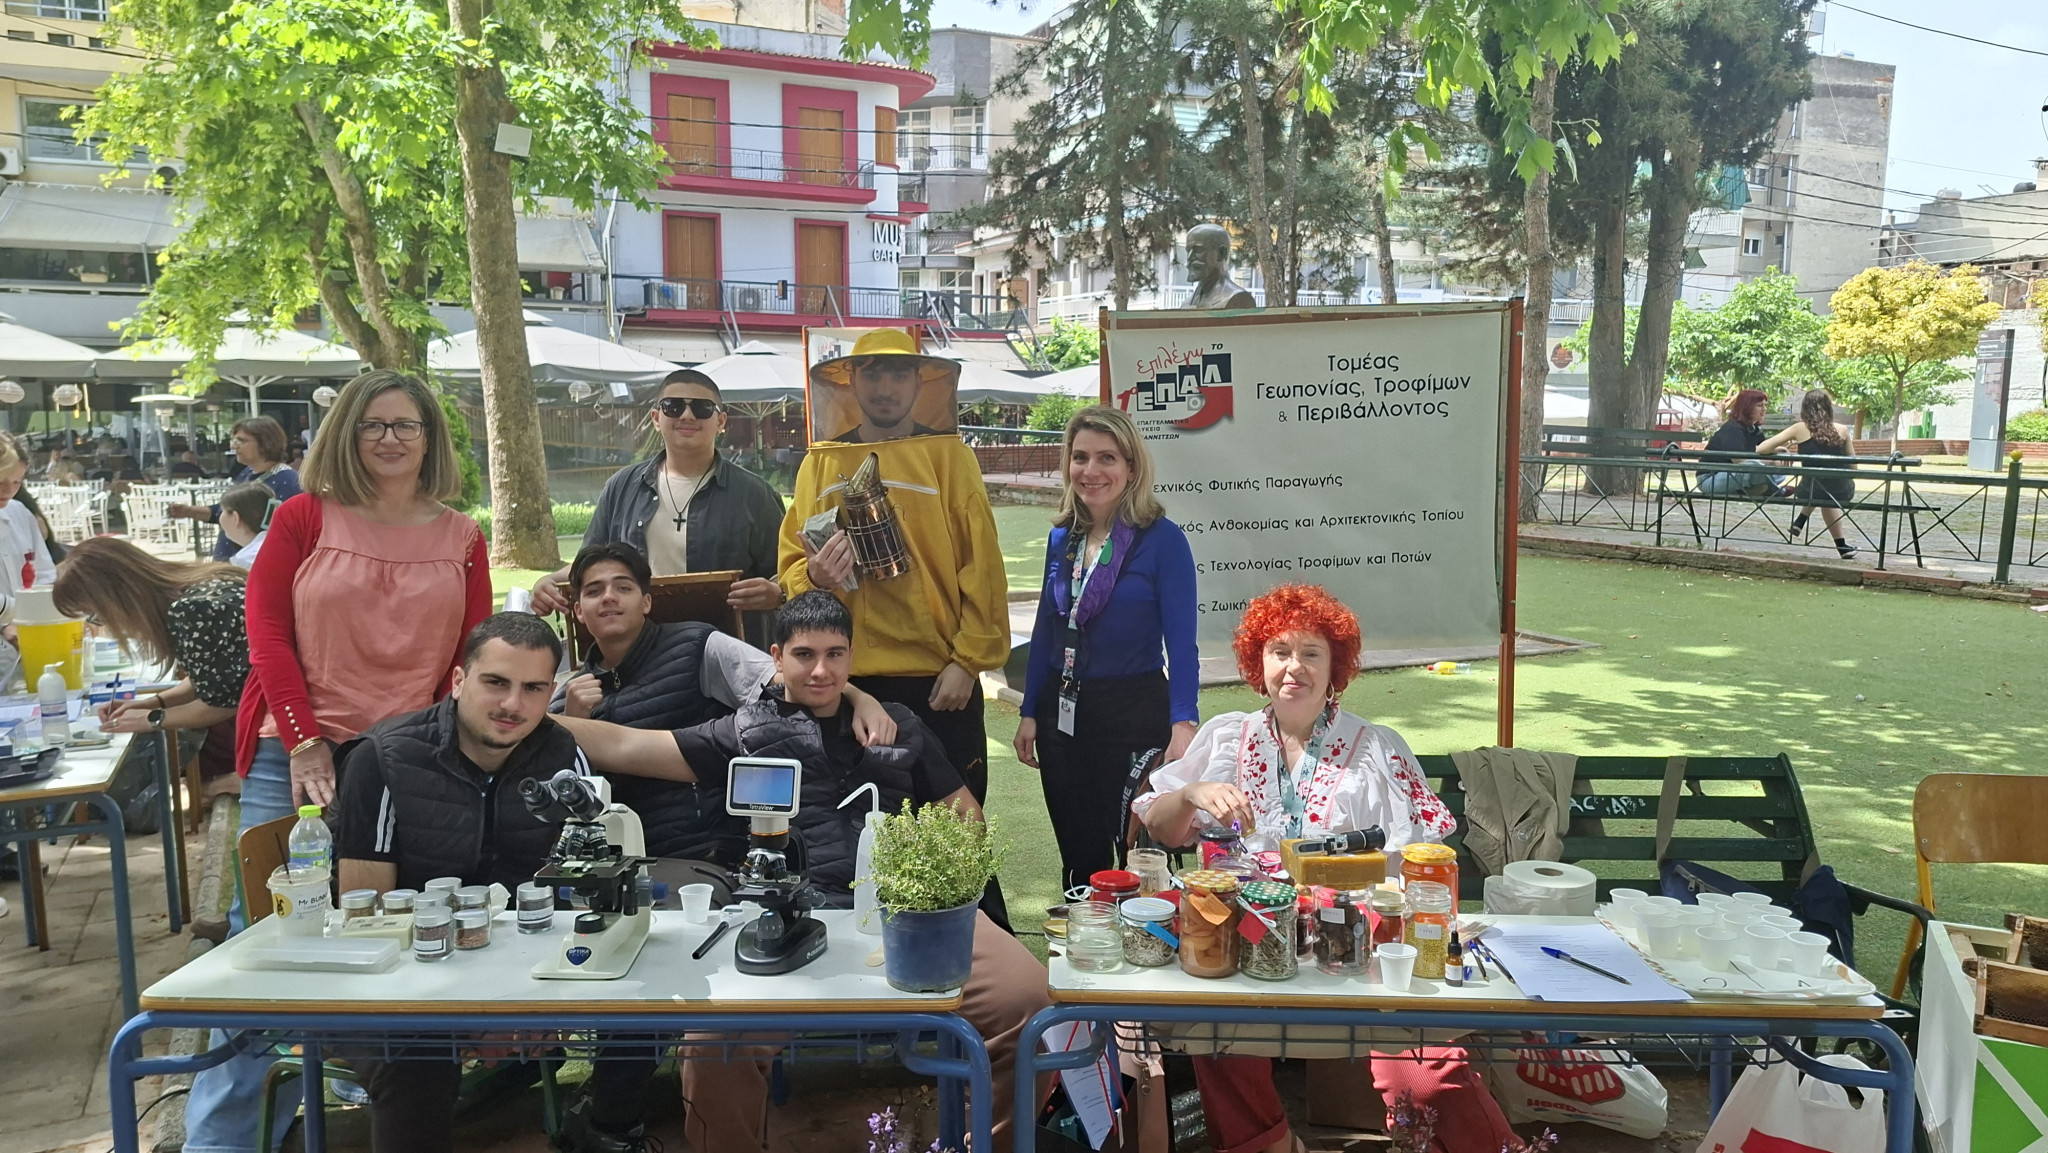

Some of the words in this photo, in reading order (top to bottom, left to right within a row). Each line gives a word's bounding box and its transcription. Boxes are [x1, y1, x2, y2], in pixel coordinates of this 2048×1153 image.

[1327, 352, 1400, 375] Τομέας
[1256, 378, 1365, 400] Γεωπονίας,
[1374, 374, 1471, 397] Τροφίμων
[1278, 411, 1288, 422] &
[1297, 400, 1449, 424] Περιβάλλοντος
[1143, 433, 1180, 441] ΑΝΝΙΤΣΩΝ
[1152, 479, 1203, 494] εχνικός
[1208, 478, 1260, 492] Φυτικής
[1265, 473, 1343, 490] Παραγωγής
[1208, 517, 1289, 533] Ανθοκομίας
[1295, 516, 1315, 528] και
[1319, 510, 1416, 529] Αρχιτεκτονικής
[1421, 508, 1465, 523] Τοπίου
[1210, 557, 1292, 572] Τεχνολογίας
[1297, 554, 1362, 571] Τροφίμων
[1366, 554, 1386, 566] και
[1391, 550, 1432, 564] Ποτών
[1211, 598, 1248, 612] Ζωική
